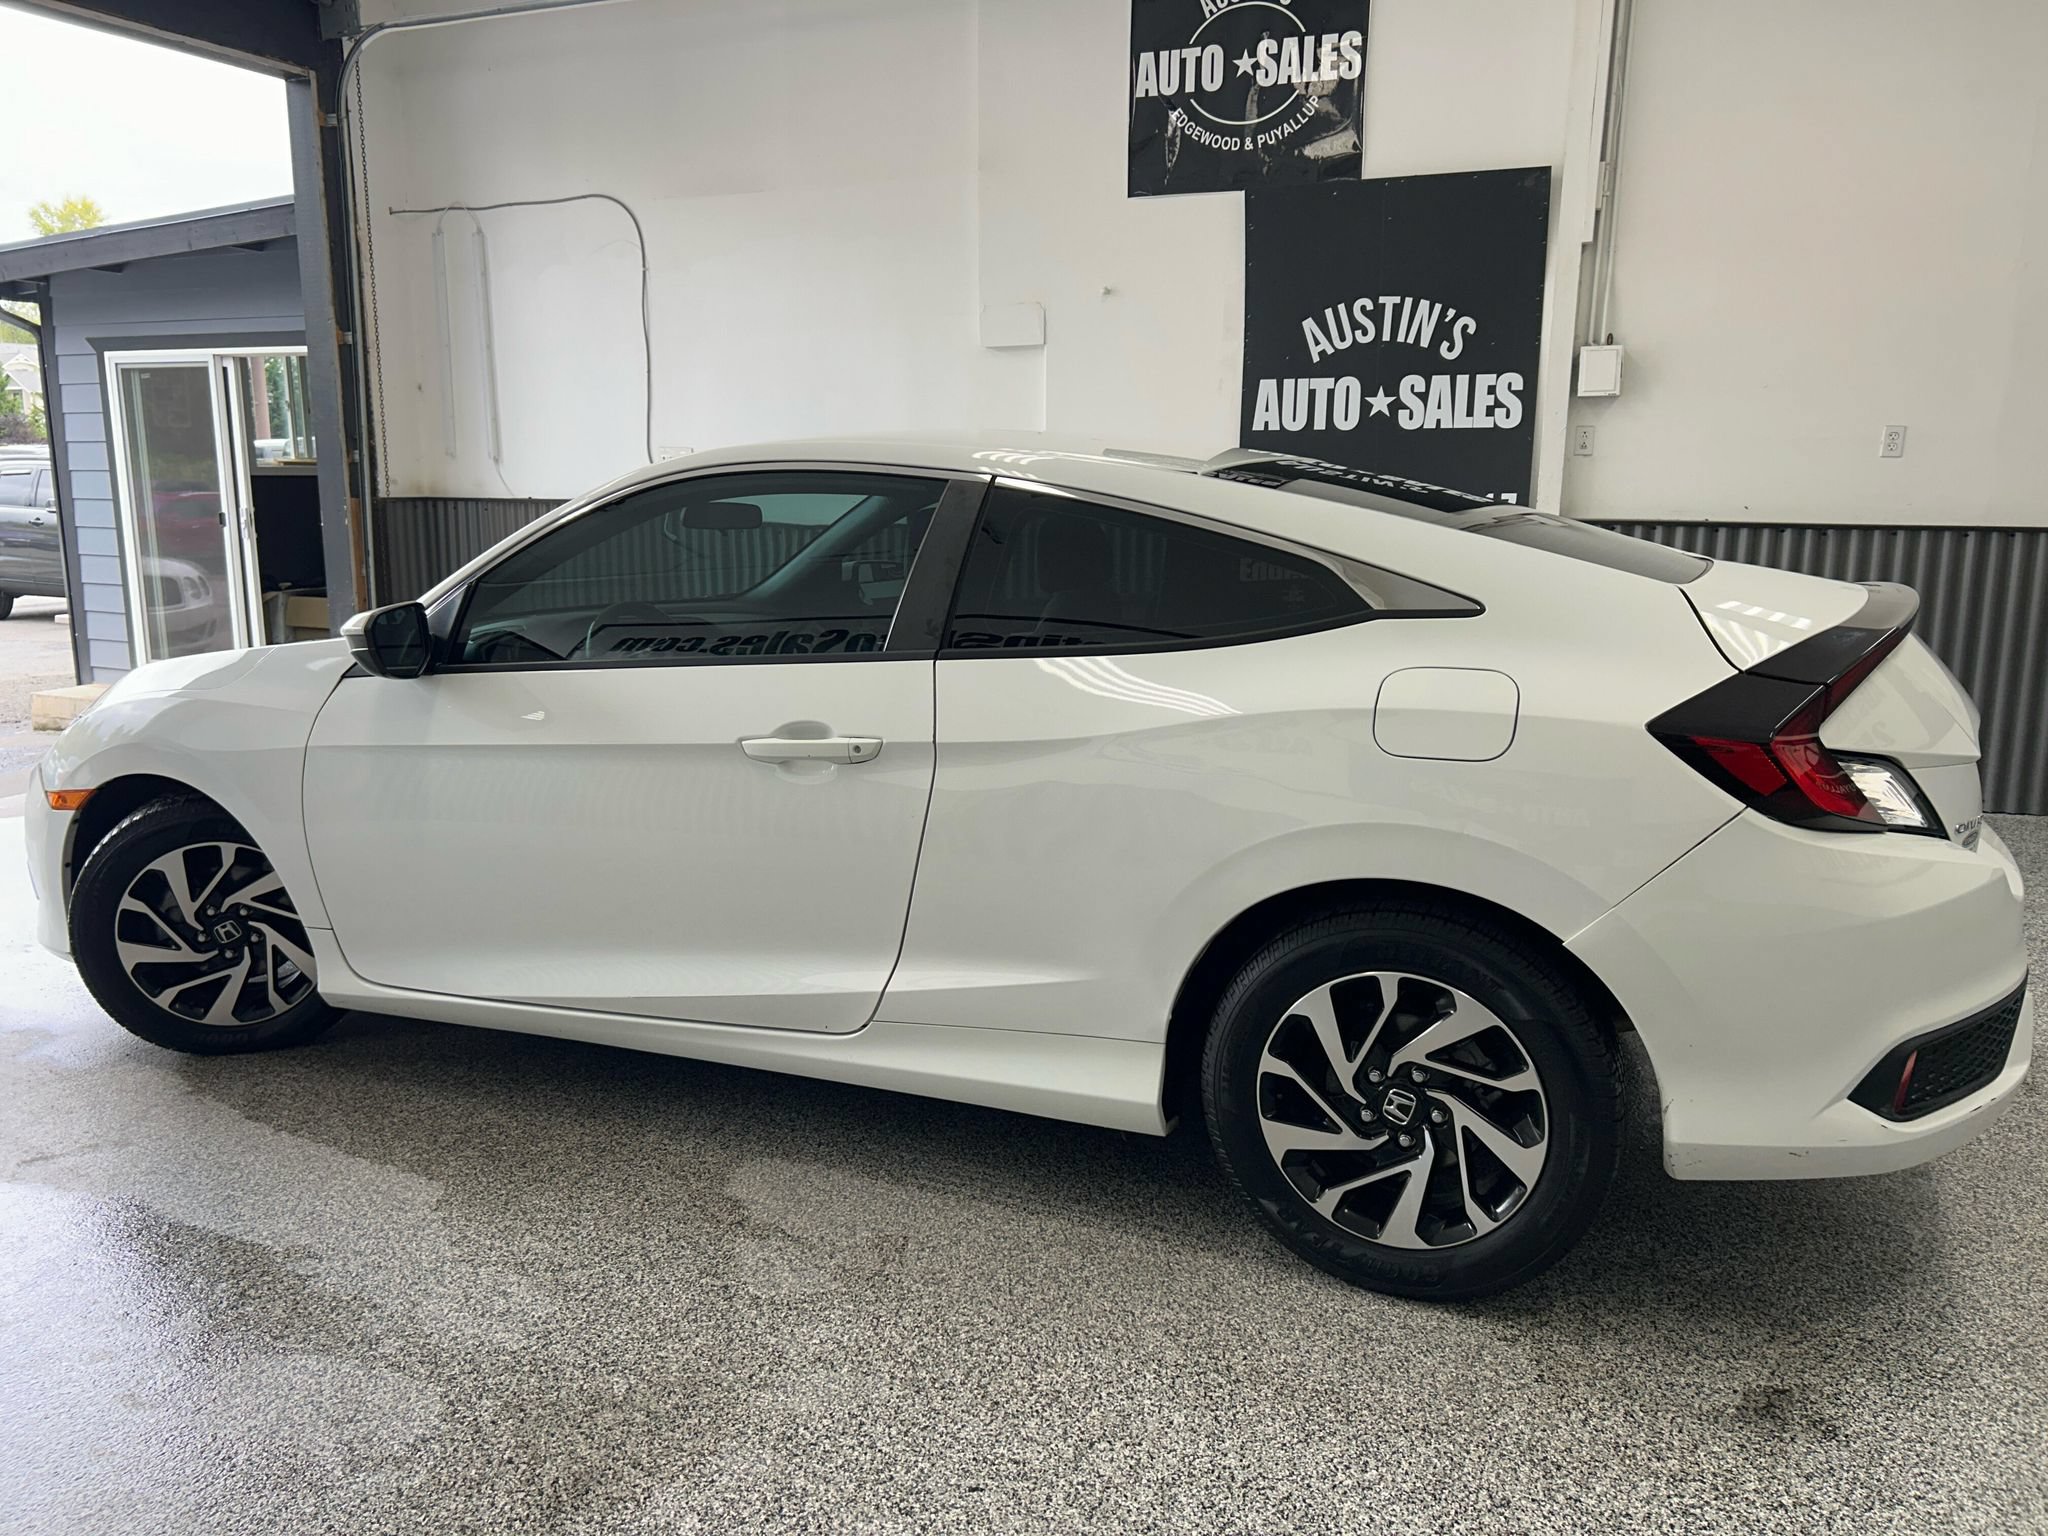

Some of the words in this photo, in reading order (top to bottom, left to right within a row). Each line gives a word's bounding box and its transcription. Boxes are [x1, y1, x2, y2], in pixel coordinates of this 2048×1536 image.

[1135, 44, 1225, 98] AUTO
[1255, 30, 1363, 87] SALES
[1172, 107, 1241, 151] EDGEWOOD
[1244, 137, 1254, 151] &
[1258, 95, 1321, 149] PUYALLUP
[1301, 296, 1477, 364] AUSTIN'S
[1252, 375, 1361, 432] AUTO
[1397, 372, 1524, 431] SALES
